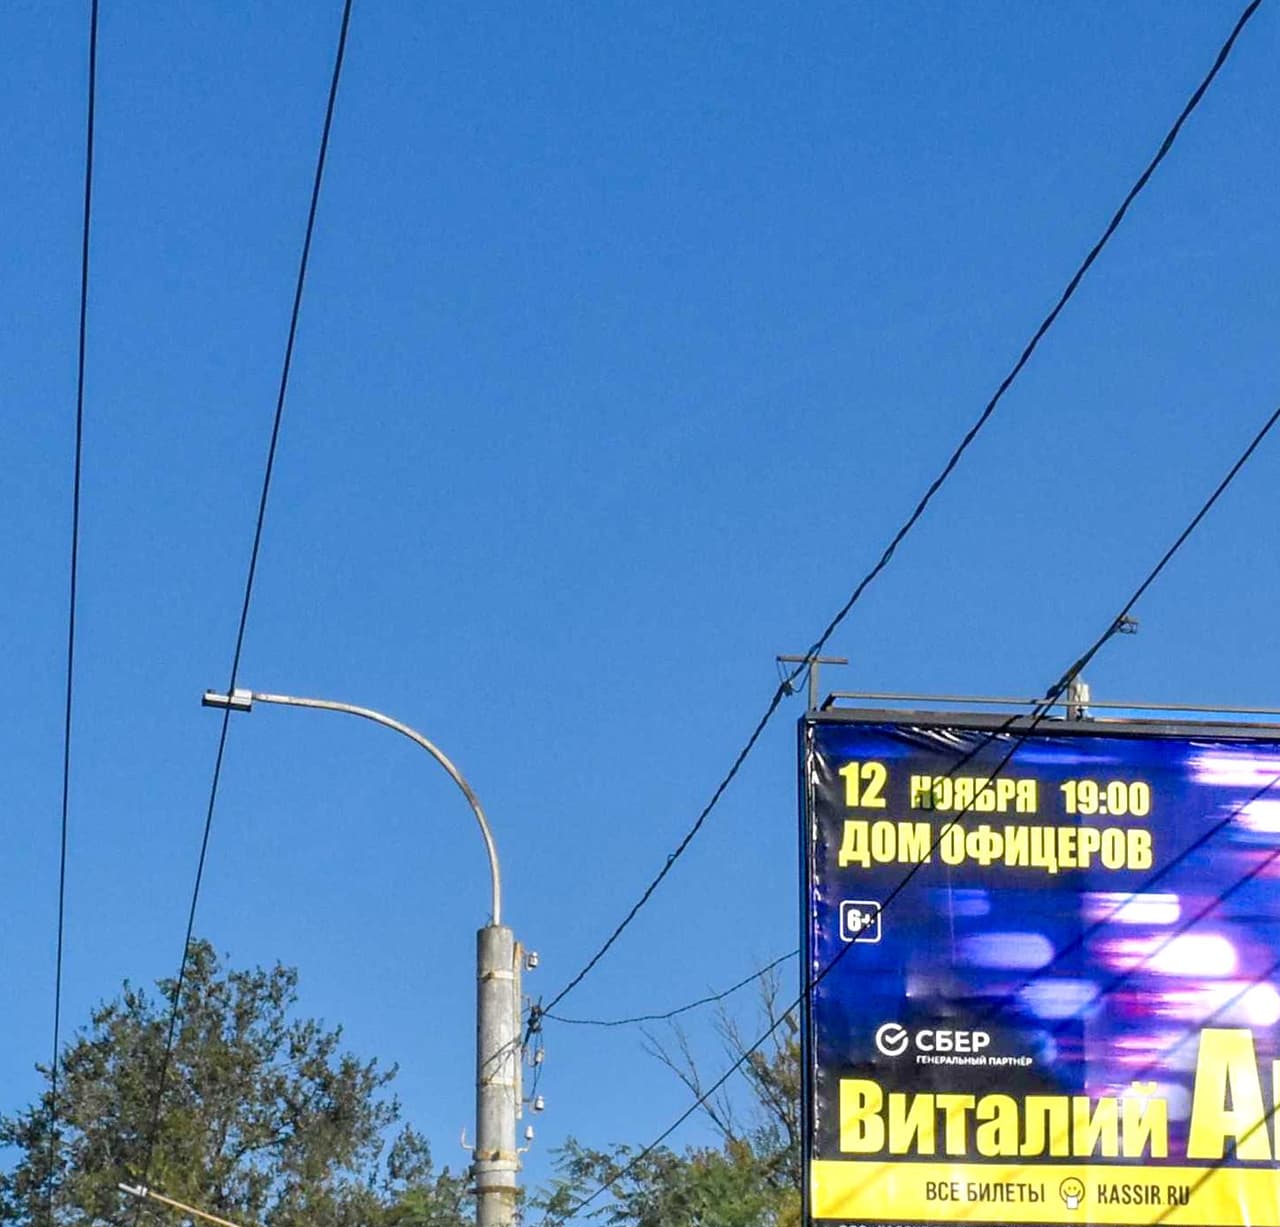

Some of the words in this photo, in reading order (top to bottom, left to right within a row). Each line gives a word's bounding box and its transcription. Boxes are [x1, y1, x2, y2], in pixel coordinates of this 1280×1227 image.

[838, 762, 887, 807] 12
[910, 775, 1037, 813] НОЯБРЯ
[1060, 780, 1150, 816] 19:00
[838, 820, 931, 868] ДОМ
[940, 823, 1153, 873] ОФИЦЕРОВ
[847, 909, 874, 931] 6+
[915, 1030, 991, 1053] СБЕР
[916, 1055, 986, 1066] ГЕНЕРАЛЬНЫЙ
[839, 1078, 1168, 1158] Виталий
[926, 1181, 960, 1201] ВСЕ
[967, 1182, 1045, 1203] БИЛЕТЫ
[1097, 1184, 1190, 1206] KASSIR.RU
